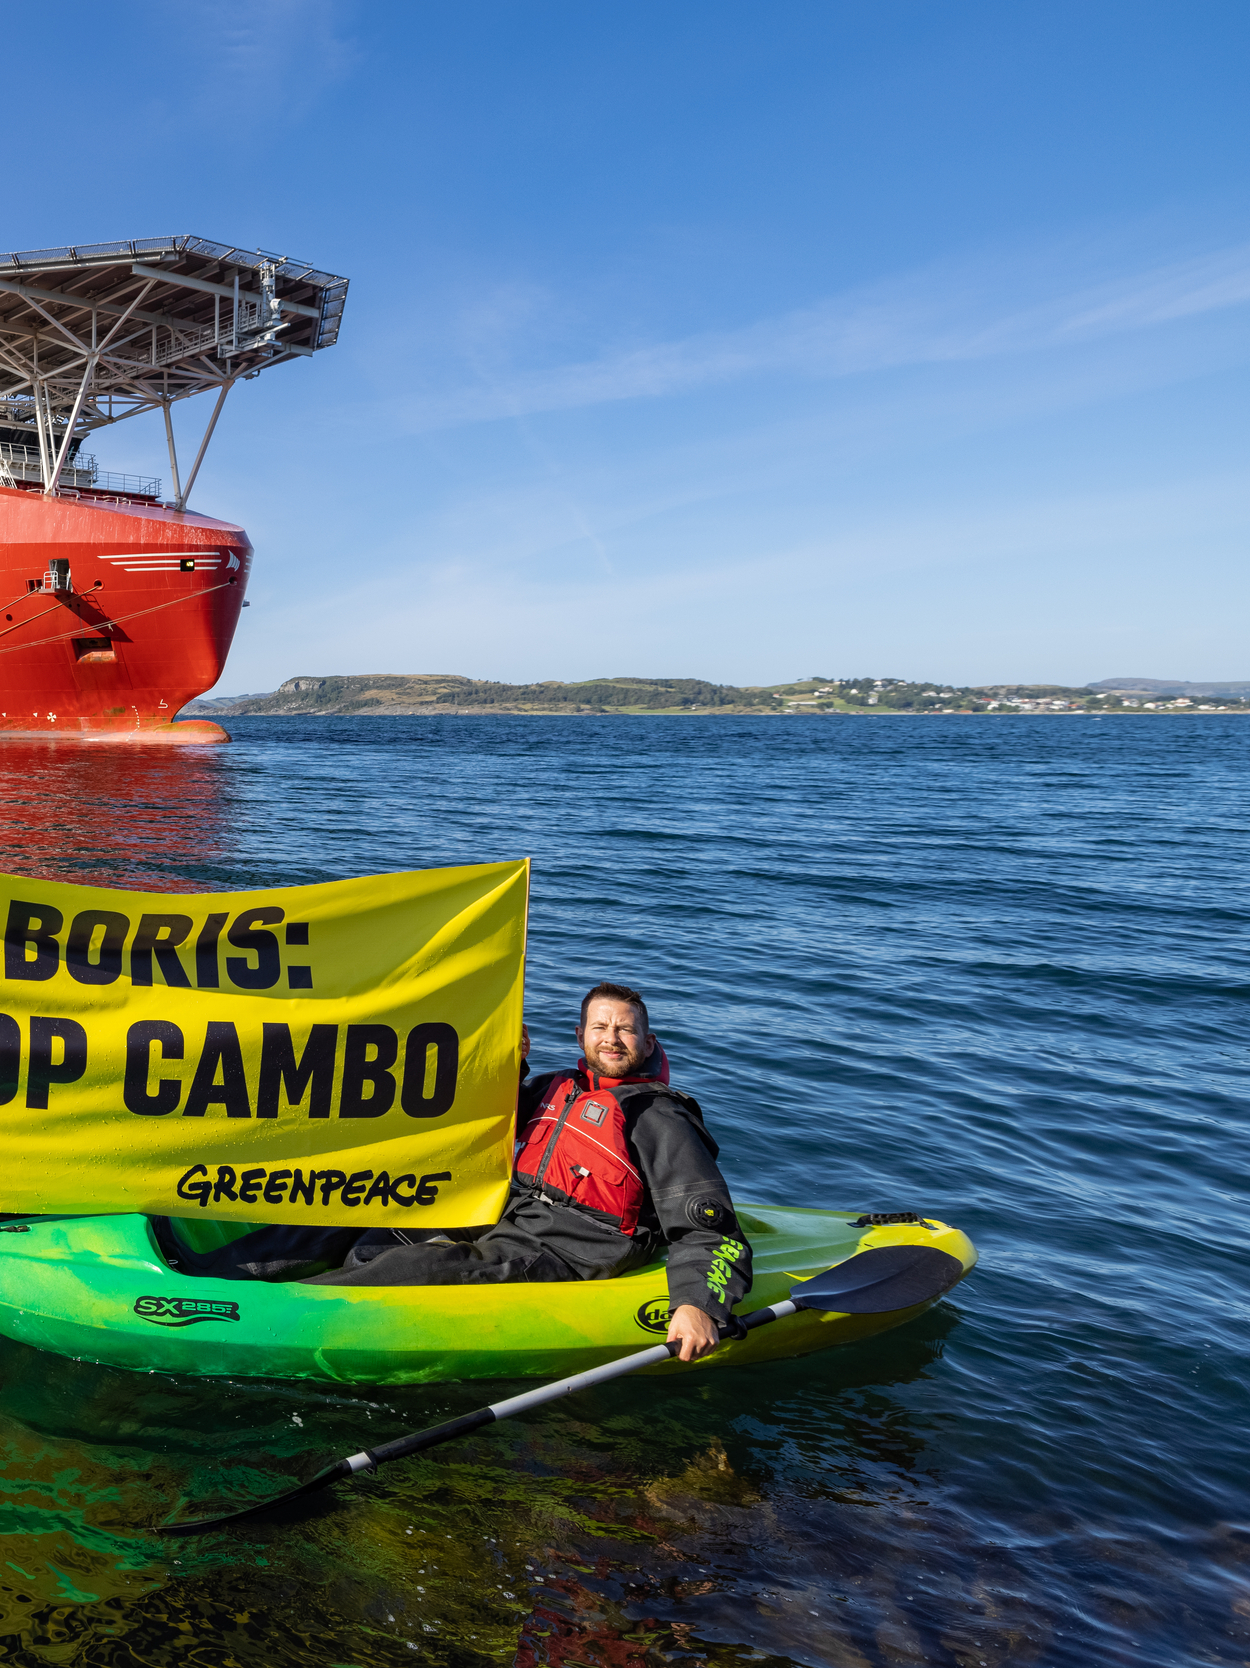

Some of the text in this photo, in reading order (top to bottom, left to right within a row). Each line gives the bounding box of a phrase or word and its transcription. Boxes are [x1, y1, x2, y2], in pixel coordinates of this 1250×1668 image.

[4, 899, 314, 990] BORIS:
[123, 1020, 459, 1119] CAMBO
[540, 1101, 556, 1111] NRS
[176, 1163, 452, 1208] GREENPEACE
